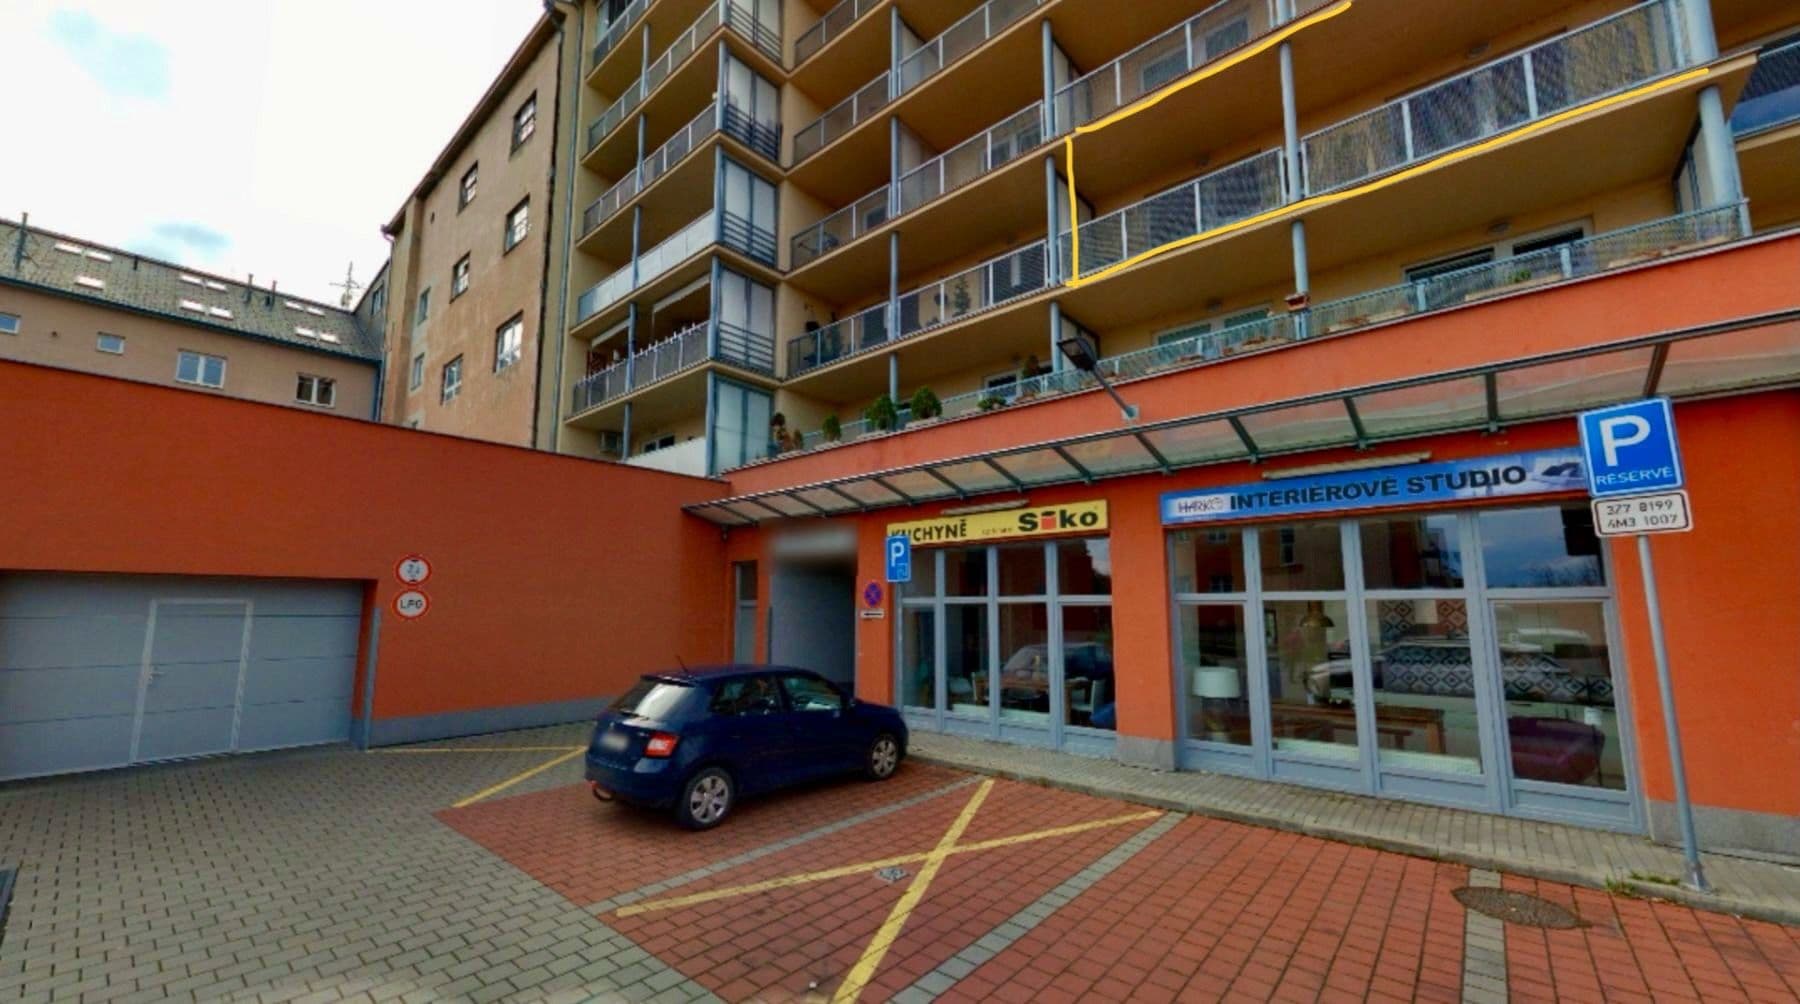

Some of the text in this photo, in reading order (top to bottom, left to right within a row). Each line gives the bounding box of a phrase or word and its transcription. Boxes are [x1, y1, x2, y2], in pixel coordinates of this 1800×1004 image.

[1600, 415, 1651, 467] P
[1407, 466, 1527, 494] STUDIO
[1018, 509, 1099, 532] Siko
[1644, 513, 1678, 526] 1007
[891, 541, 905, 567] P
